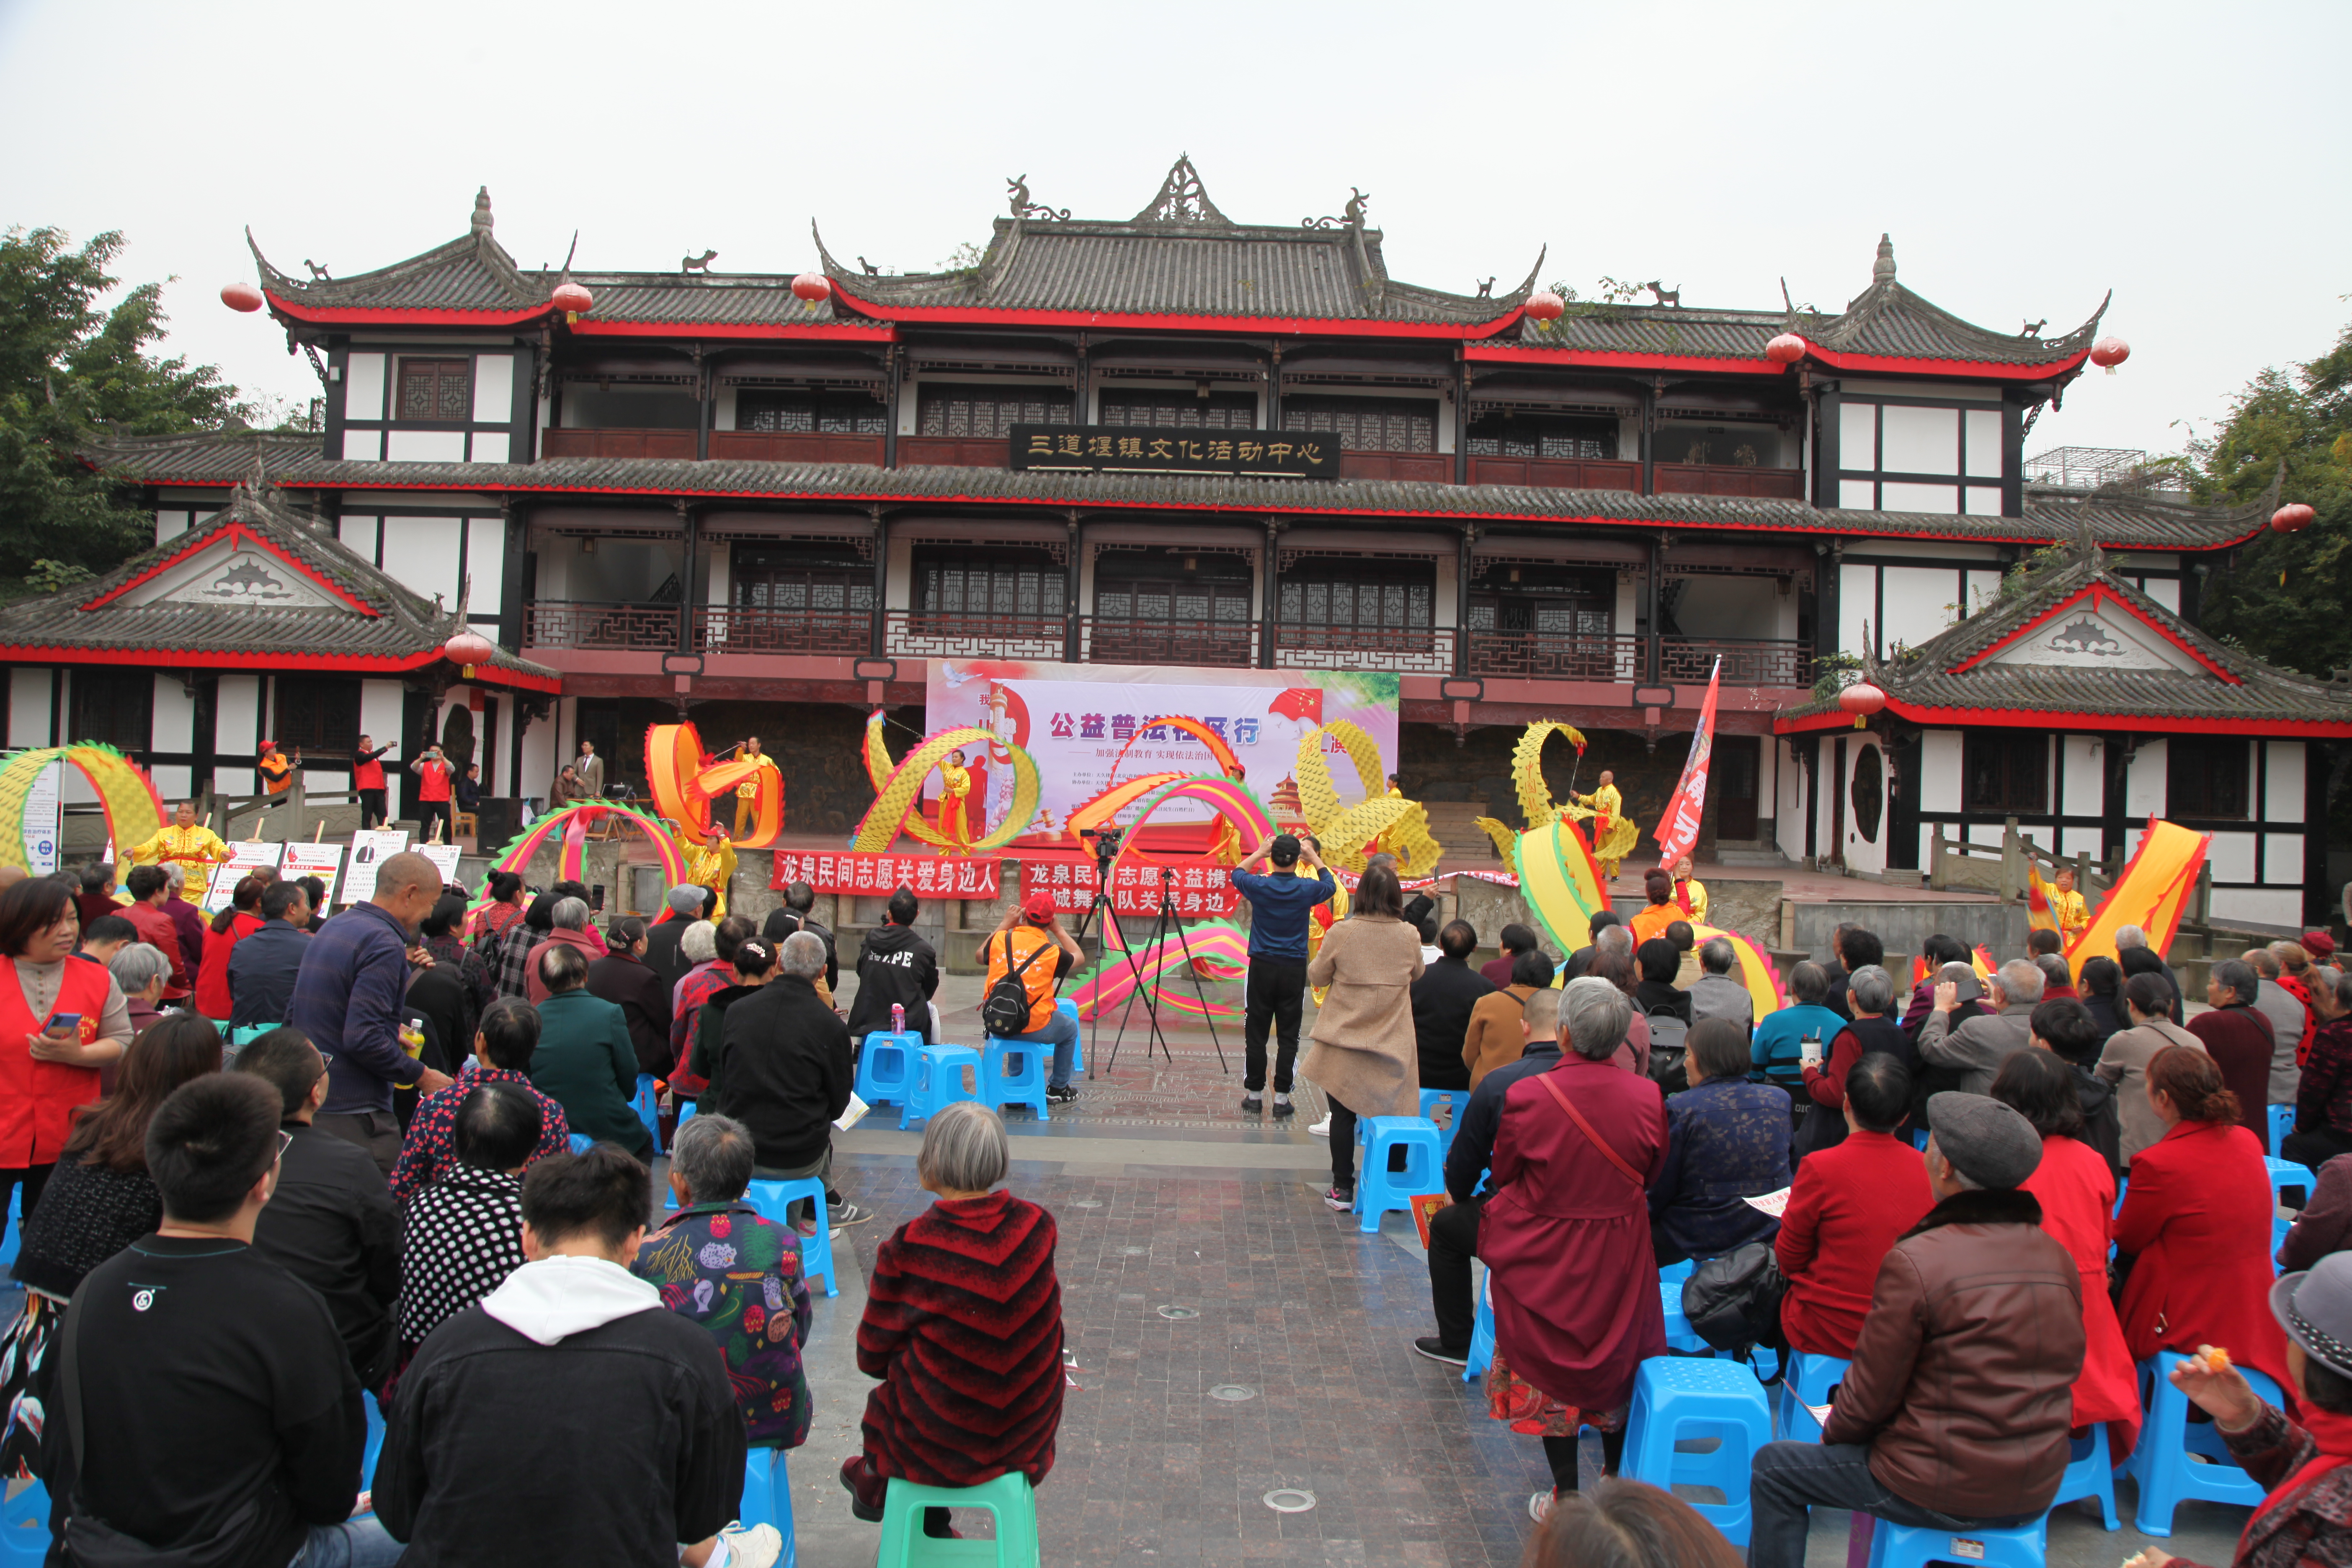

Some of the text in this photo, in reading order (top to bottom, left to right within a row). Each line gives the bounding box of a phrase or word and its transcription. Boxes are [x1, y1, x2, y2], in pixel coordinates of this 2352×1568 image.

[1028, 434, 1323, 464] 三道堰镇文化活动中心
[781, 854, 996, 893] 龙泉民间志愿关爱身边人
